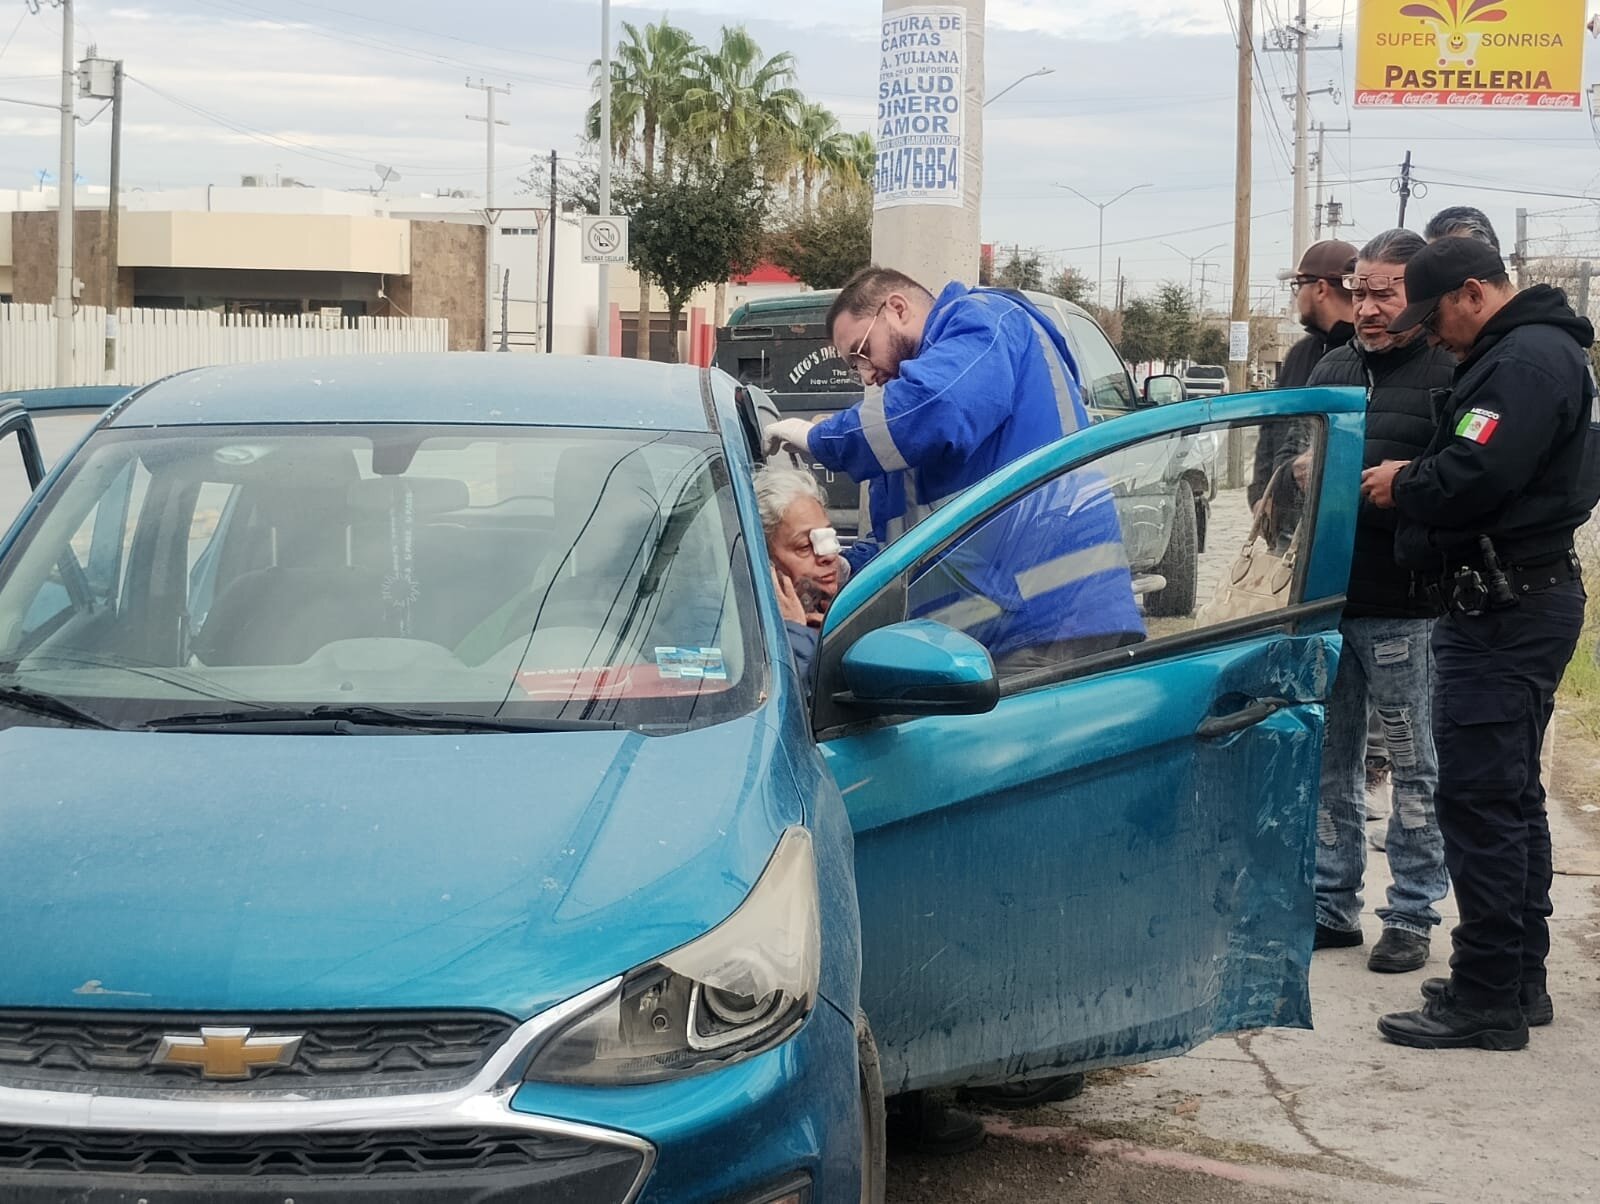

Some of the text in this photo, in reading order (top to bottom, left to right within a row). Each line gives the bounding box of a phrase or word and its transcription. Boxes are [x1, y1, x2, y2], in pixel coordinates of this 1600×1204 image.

[882, 16, 960, 36] CTURA DE
[881, 32, 941, 52] CARTAS
[1376, 33, 1563, 47] SUPER SONRISA
[895, 50, 959, 67] YULIANA
[916, 66, 959, 74] IMPOSIBLE
[1385, 65, 1552, 89] PASTELERIA
[879, 76, 953, 99] SALUD
[882, 115, 949, 137] AMOR
